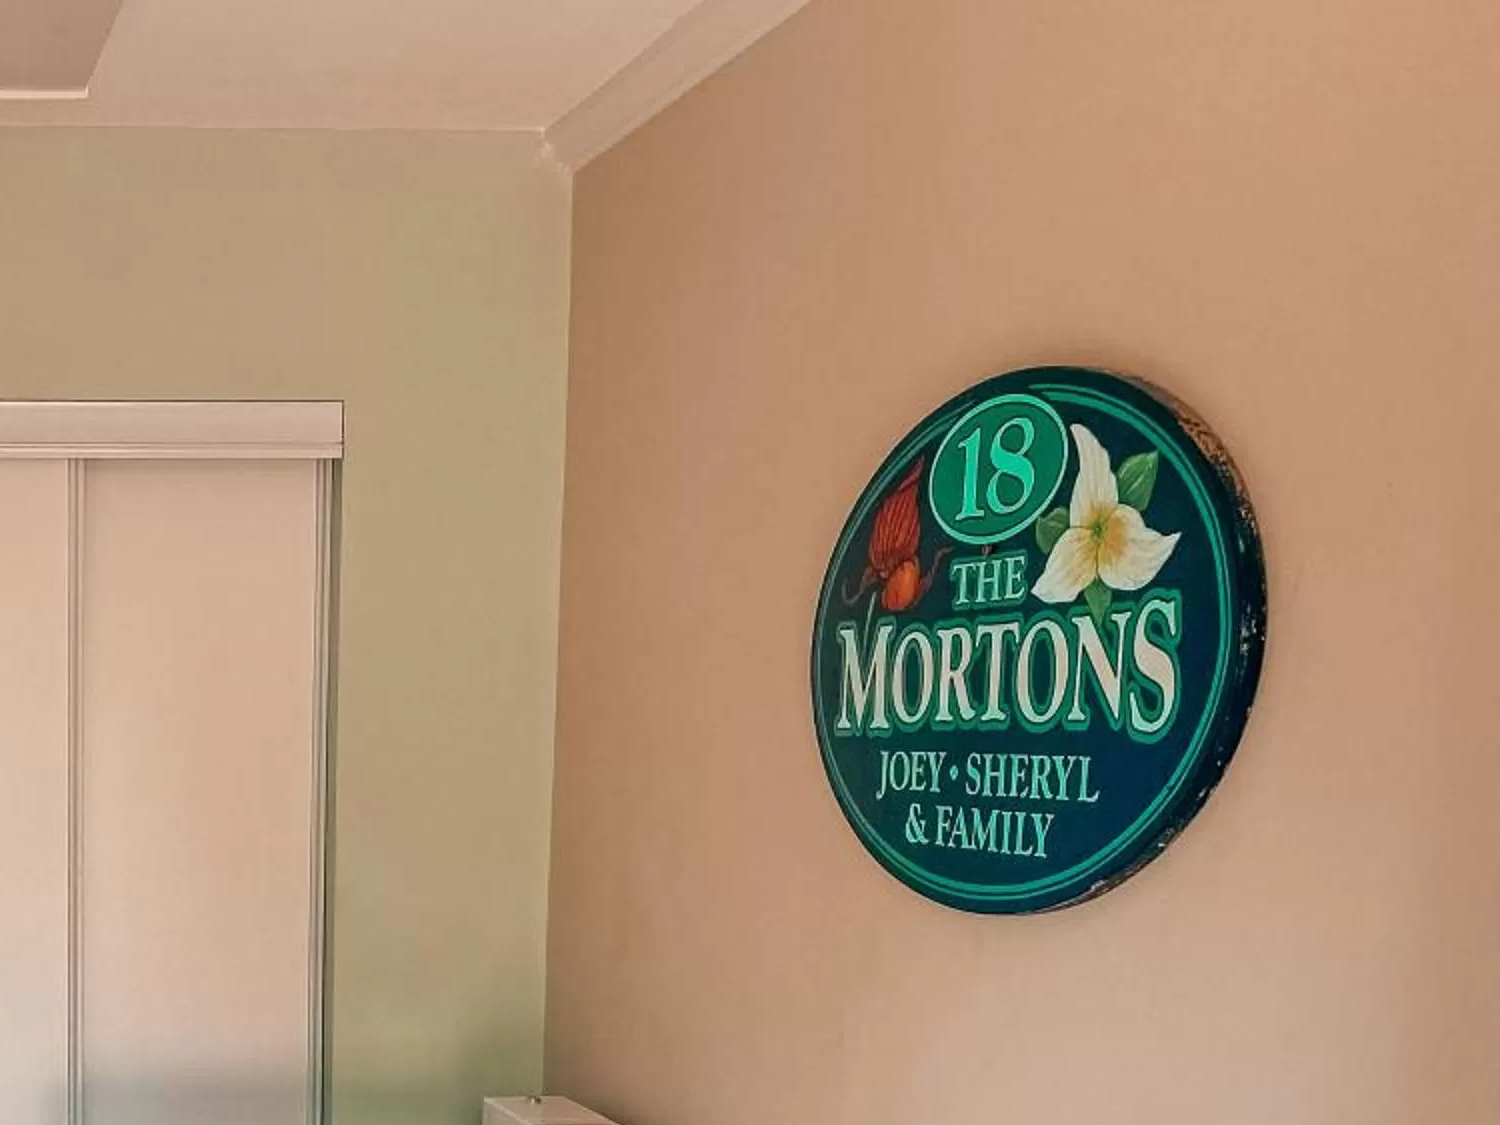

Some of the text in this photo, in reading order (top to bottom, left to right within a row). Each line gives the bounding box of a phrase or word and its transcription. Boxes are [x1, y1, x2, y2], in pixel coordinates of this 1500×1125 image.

[955, 417, 1036, 522] 18
[952, 555, 1027, 606] THE
[836, 597, 1181, 733] MORTONS
[876, 751, 1099, 803] JOEY SHERYL
[904, 803, 1055, 858] & FAMILY
